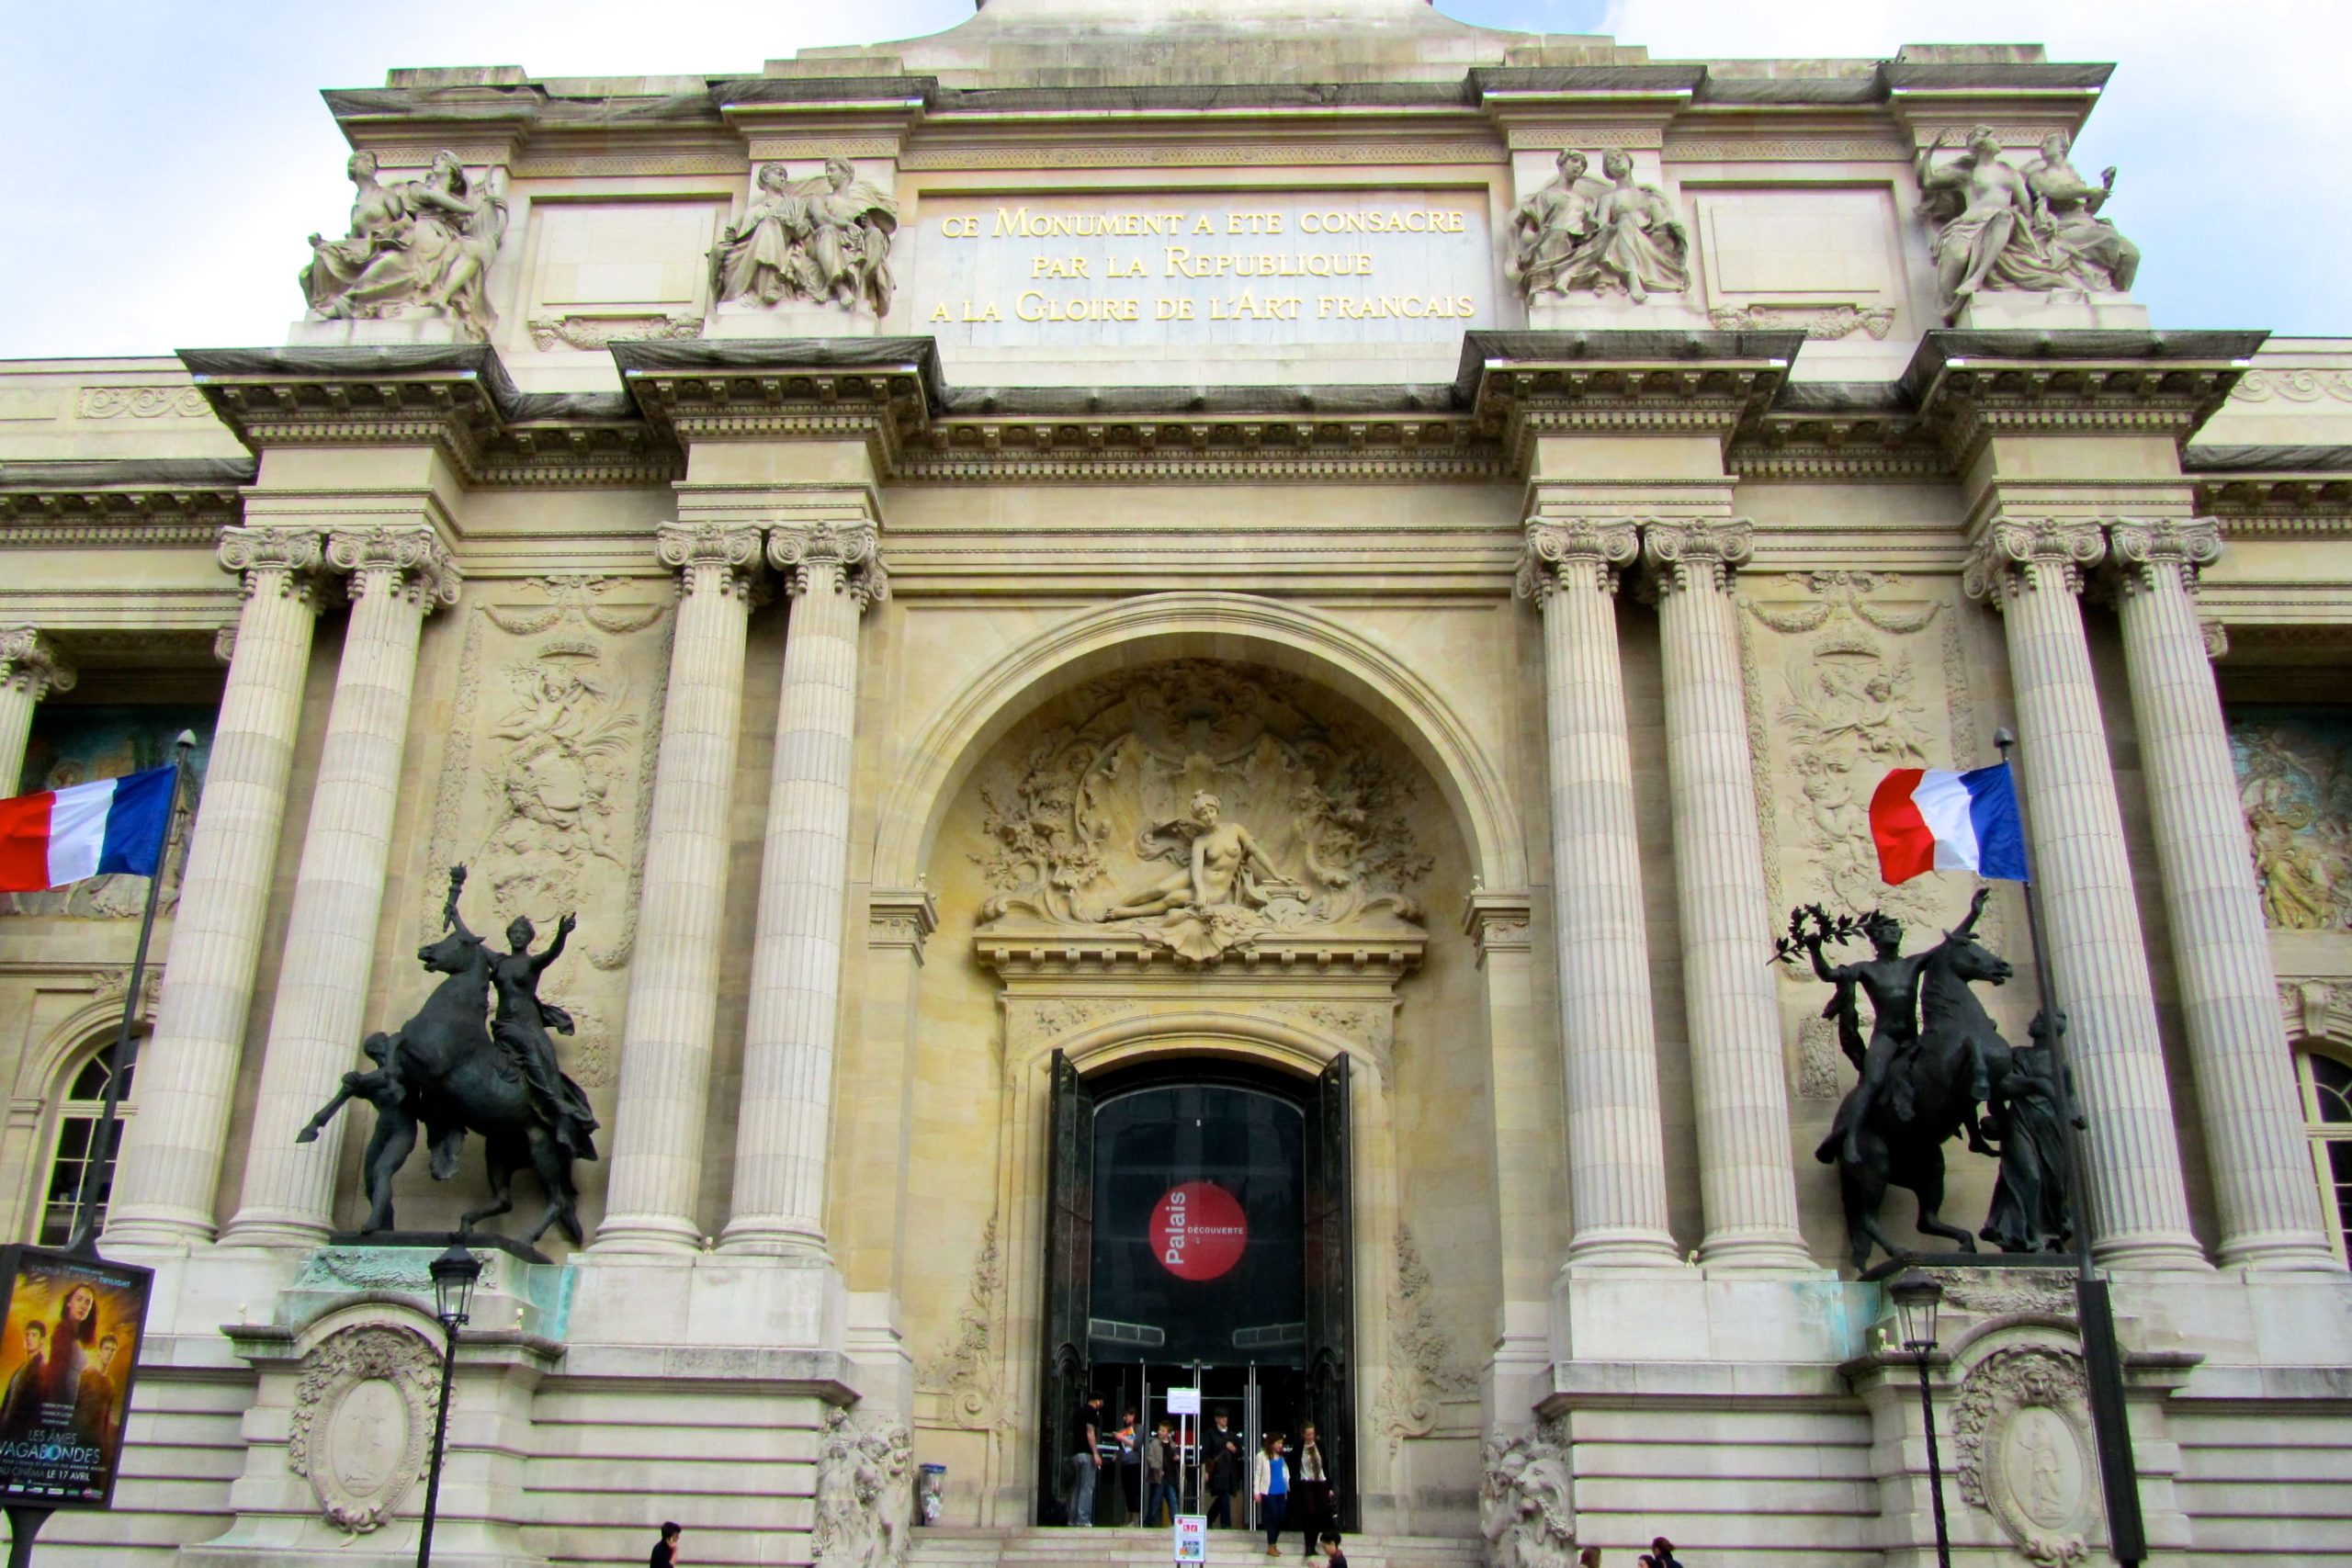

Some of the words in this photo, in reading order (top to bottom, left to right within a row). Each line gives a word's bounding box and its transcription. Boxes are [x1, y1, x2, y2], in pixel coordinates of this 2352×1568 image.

[941, 216, 979, 238] CE
[991, 207, 1185, 237] MONUMENT
[1191, 213, 1215, 234] A
[1227, 212, 1284, 234] ETE
[1300, 210, 1465, 233] CONSACRE
[1031, 256, 1091, 279] PAR
[1106, 256, 1148, 277] LA
[1163, 245, 1374, 279] REPUBLIQUE
[929, 301, 952, 322] A
[961, 300, 1002, 322] LA
[1015, 289, 1139, 322] GLOIRE
[1155, 298, 1195, 321] DE
[1209, 288, 1303, 321] L'ART
[1317, 295, 1476, 320] FRANCAIS
[1165, 1191, 1185, 1264] Palais
[98, 1276, 131, 1288] TWILIGHT
[28, 1429, 46, 1441] LES
[48, 1428, 77, 1445] ÂMES
[47, 1469, 57, 1479] LE
[59, 1470, 69, 1480] 17
[69, 1471, 90, 1481] AVRIL
